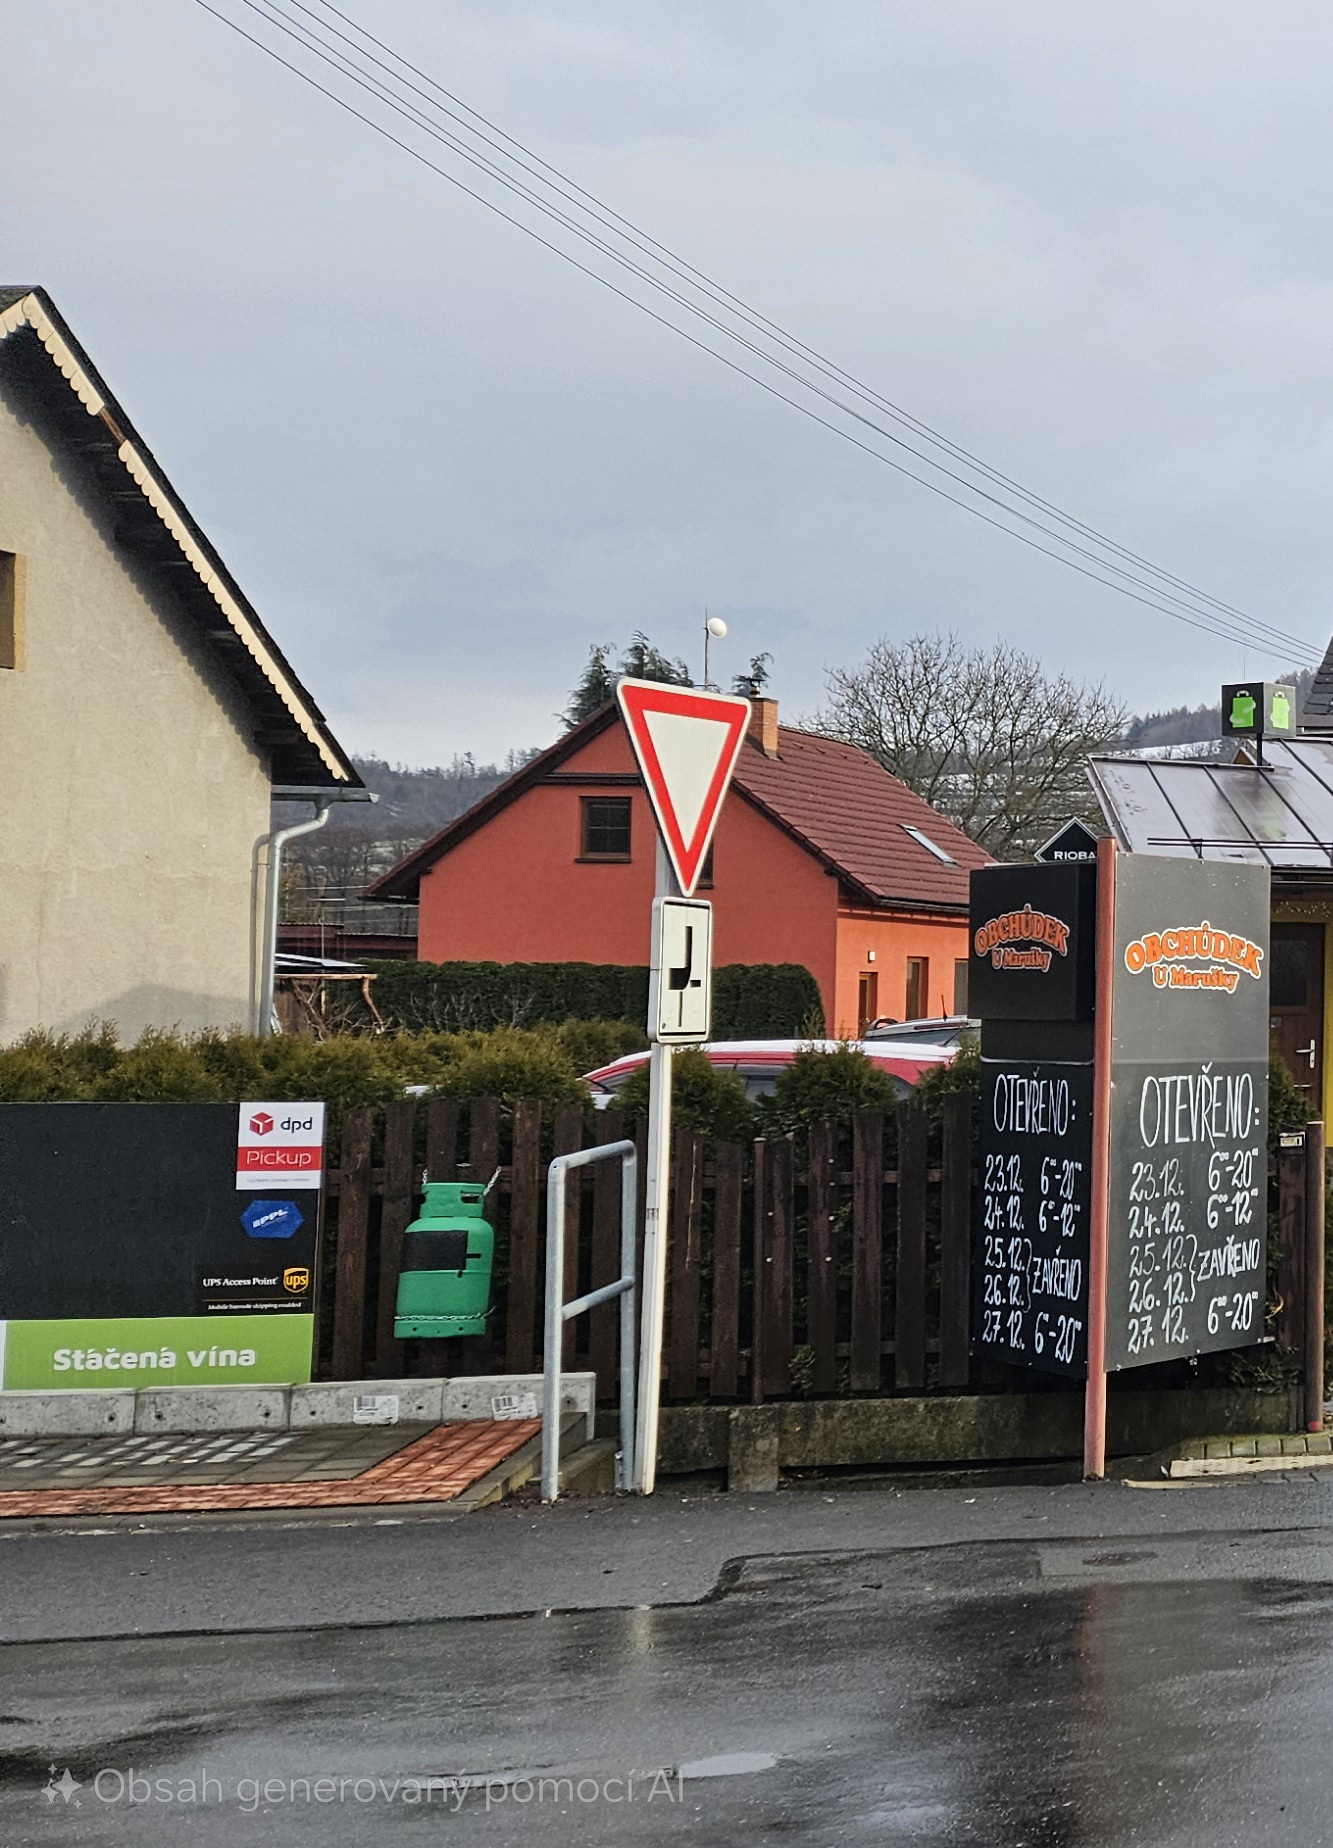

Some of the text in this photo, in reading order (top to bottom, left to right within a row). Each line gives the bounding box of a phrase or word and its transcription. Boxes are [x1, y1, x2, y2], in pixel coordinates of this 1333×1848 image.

[1053, 850, 1096, 860] RIOBA
[975, 904, 1069, 956] OBCHŮDEK
[992, 947, 1052, 972] U Marušky
[1125, 920, 1264, 979] OBCHŮDEK
[1152, 964, 1239, 993] U Marušky
[1140, 1062, 1260, 1149] OTEVŘENO:
[280, 1117, 313, 1133] dpd
[246, 1150, 312, 1167] Pickup
[1197, 1235, 1261, 1282] ZAVŘENO
[203, 1278, 221, 1287] UPS
[222, 1278, 251, 1286] Access
[285, 1275, 307, 1289] ups
[53, 1346, 256, 1371] Stáčená vína
